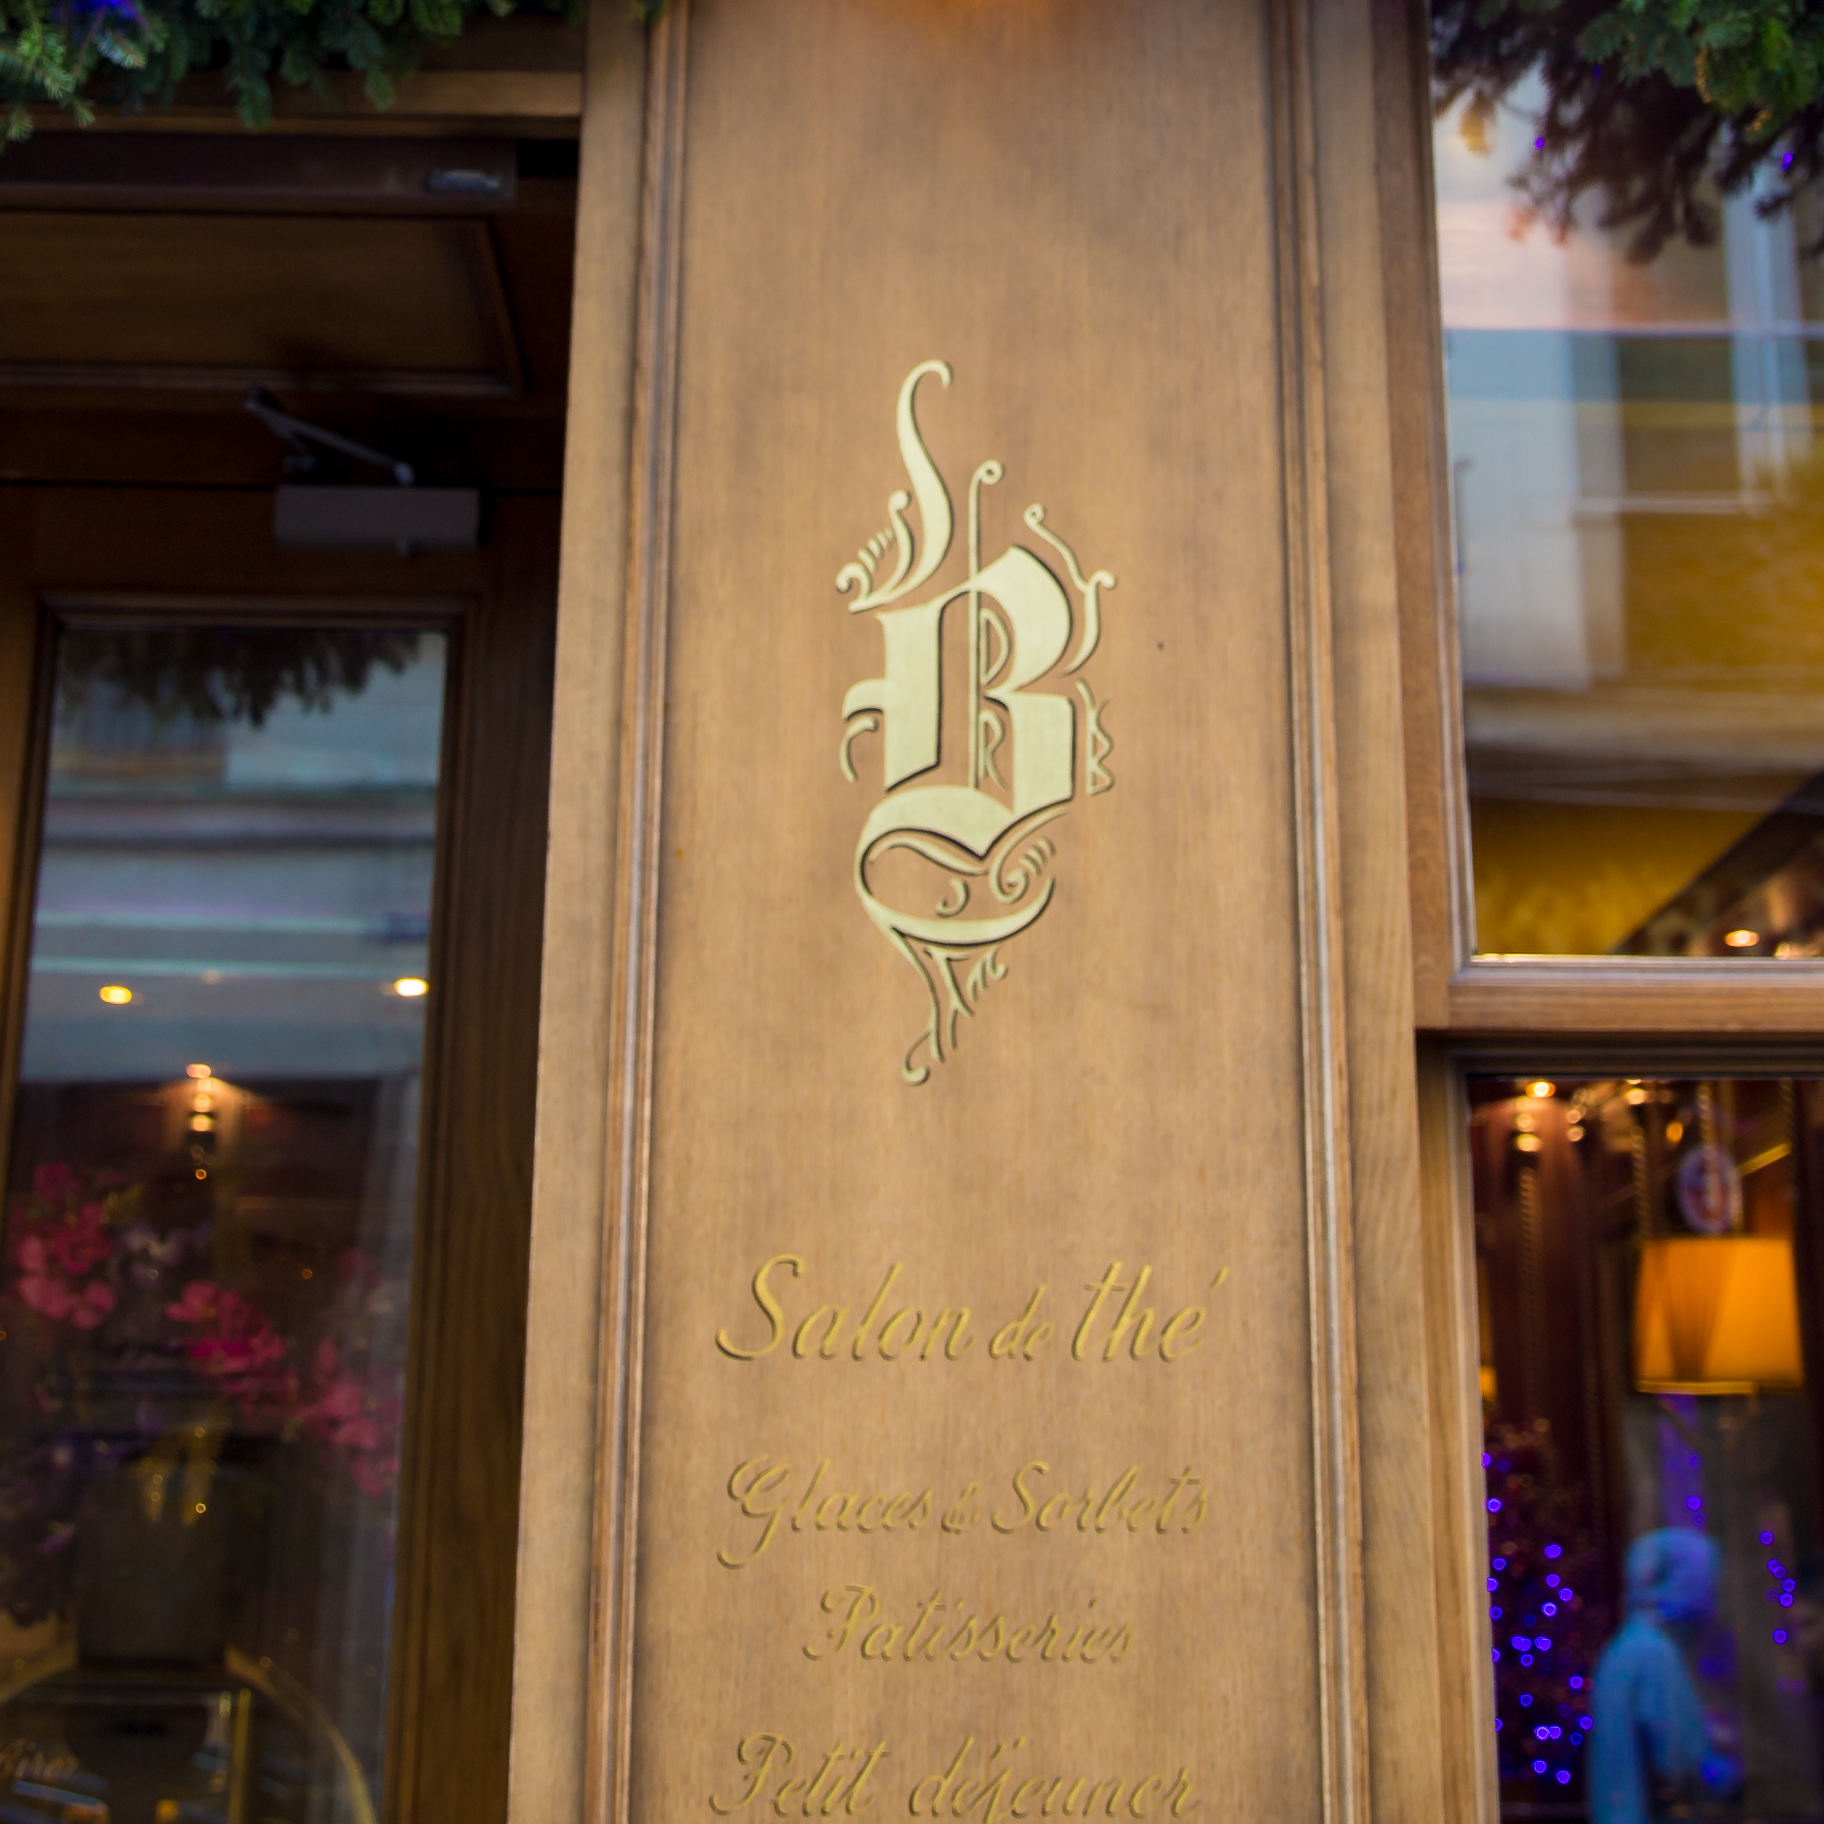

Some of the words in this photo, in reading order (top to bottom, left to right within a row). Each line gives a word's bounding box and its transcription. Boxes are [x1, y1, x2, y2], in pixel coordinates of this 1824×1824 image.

[716, 1254, 975, 1362] Salon
[989, 1283, 1055, 1362] de
[1072, 1260, 1229, 1363] thé
[717, 1453, 933, 1570] Glaces
[991, 1460, 1208, 1535] Sorbets
[708, 1731, 891, 1818] Petit
